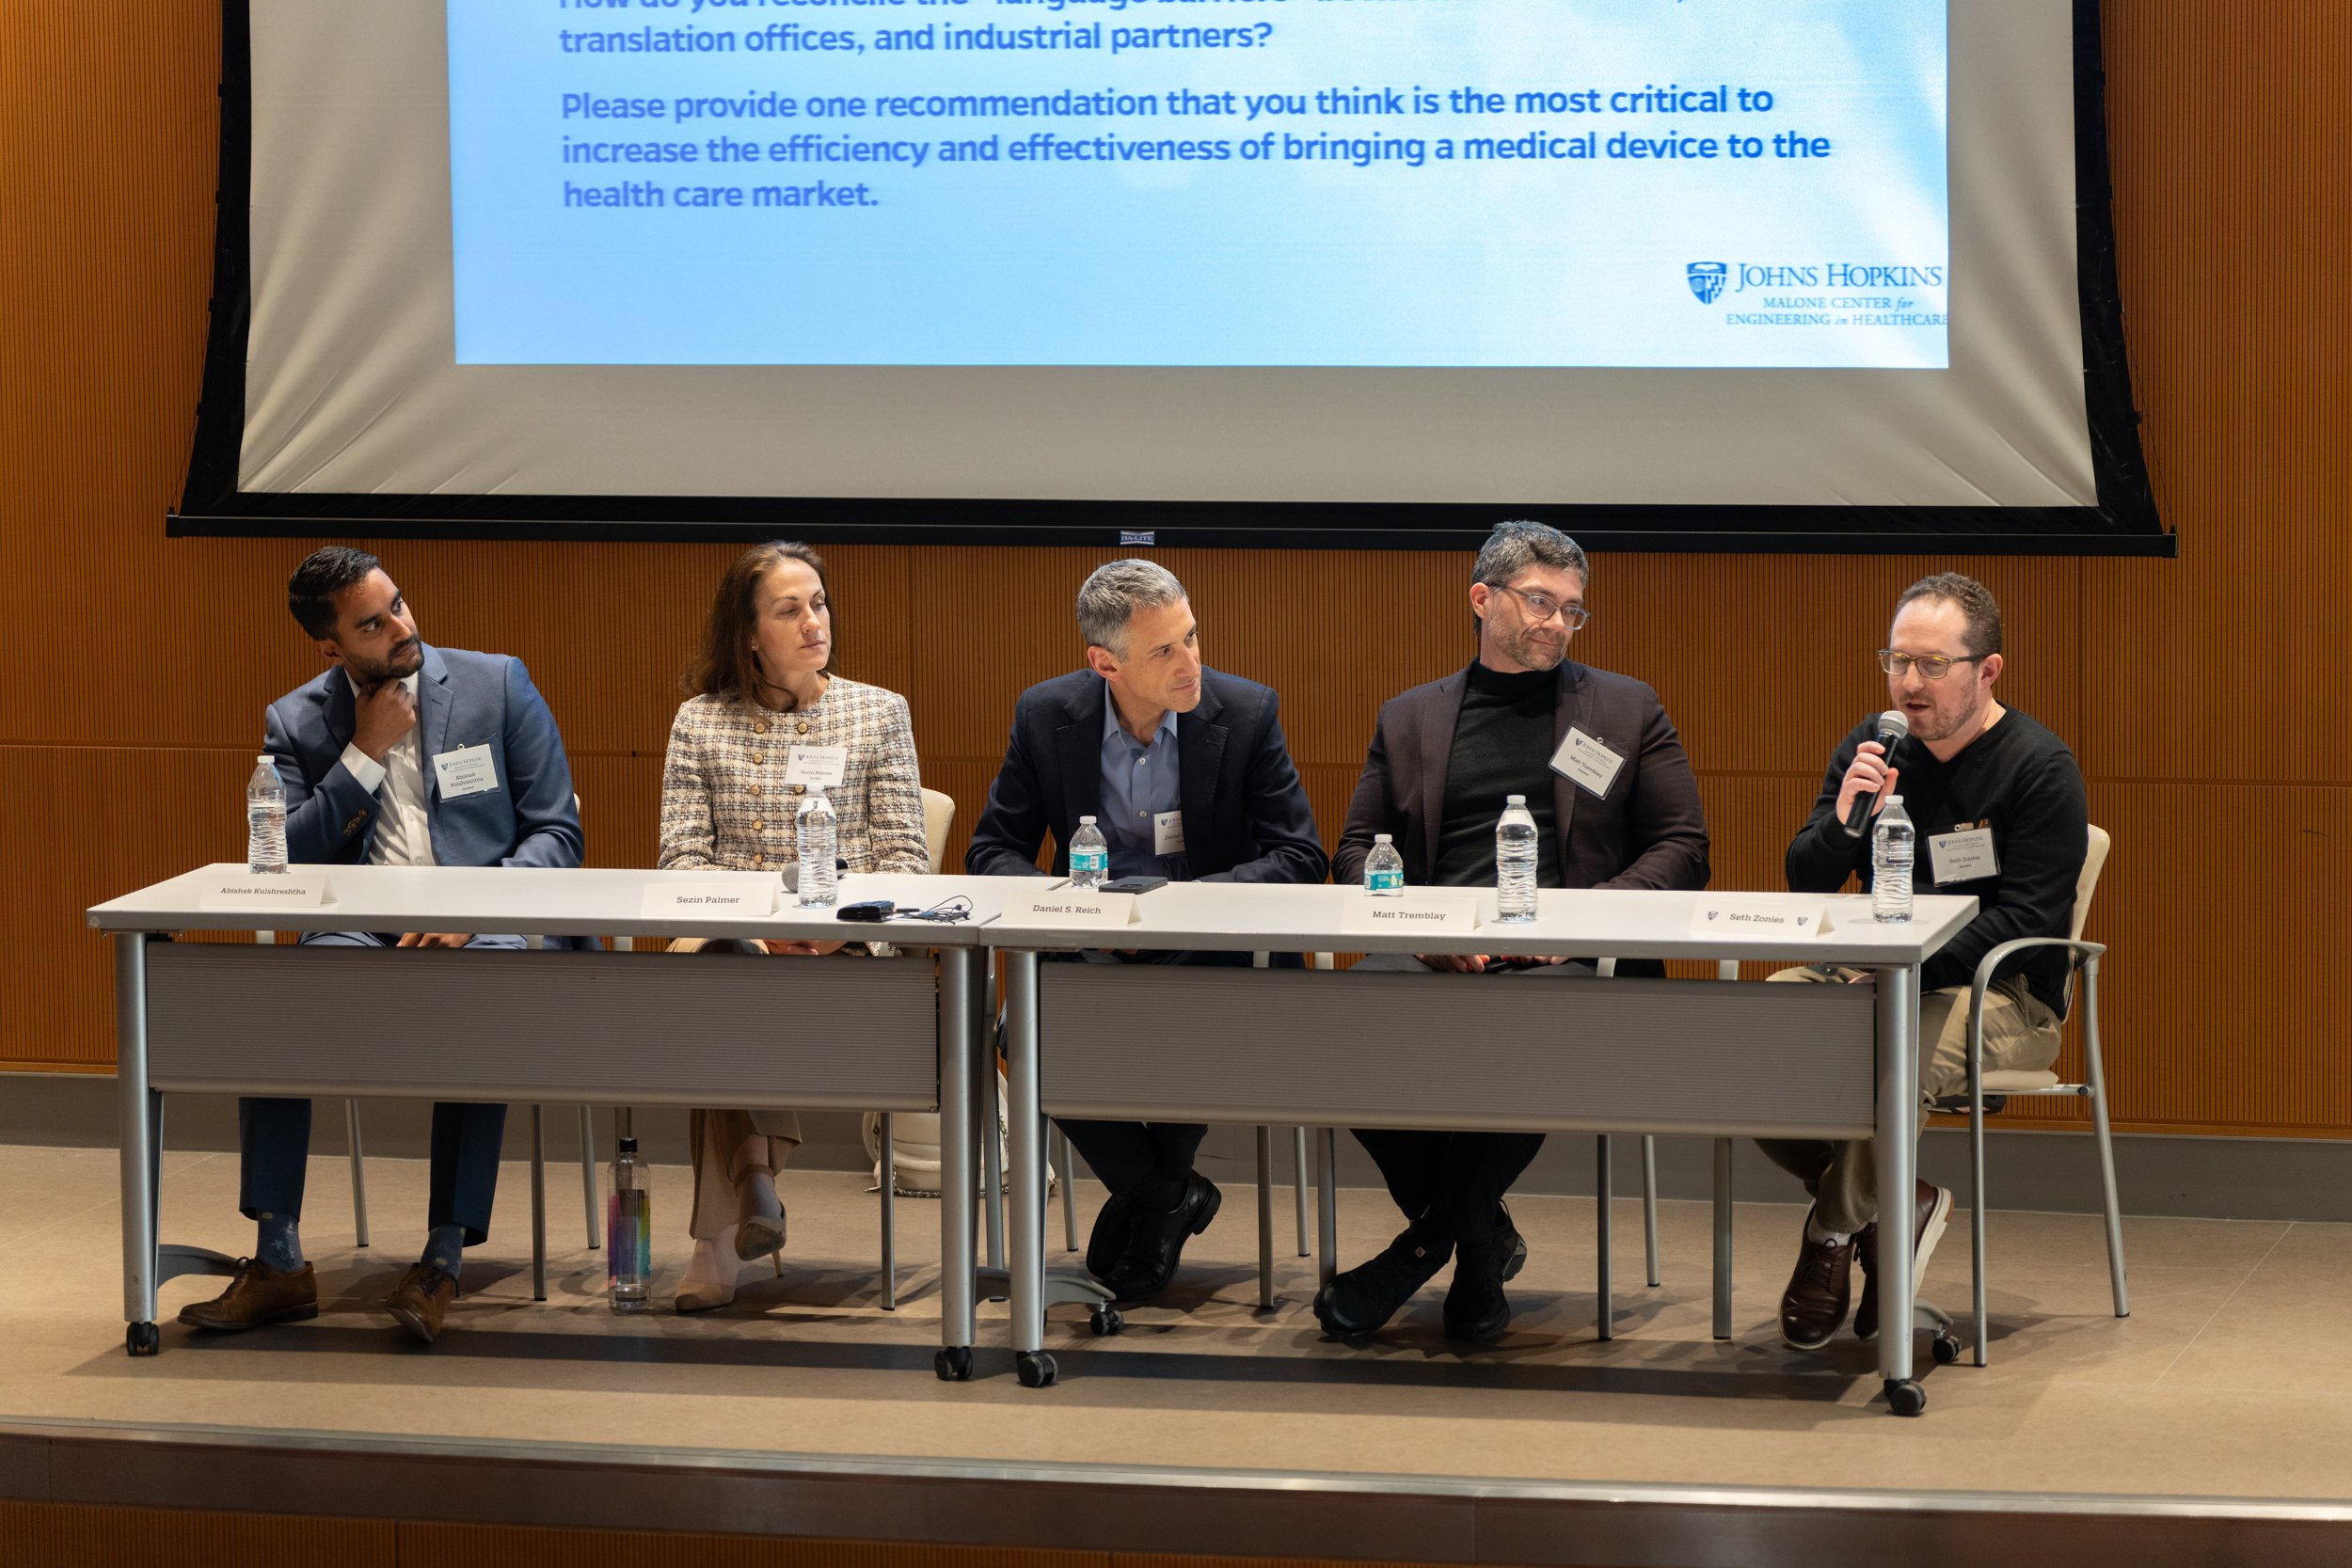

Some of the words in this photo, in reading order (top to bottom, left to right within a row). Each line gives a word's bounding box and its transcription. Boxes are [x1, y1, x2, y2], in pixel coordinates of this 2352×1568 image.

[560, 24, 736, 53] translation
[745, 24, 866, 55] offices,
[874, 24, 935, 51] and
[945, 21, 1102, 50] industrial
[1111, 22, 1274, 55] partners?
[564, 92, 665, 119] Please
[675, 90, 798, 123] provide
[806, 97, 866, 118] one
[876, 87, 1158, 118] recommendation
[1166, 88, 1237, 116] that
[1243, 94, 1307, 120] you
[1314, 86, 1406, 115] think
[1413, 85, 1440, 114] is
[1448, 86, 1506, 114] the
[1515, 88, 1603, 114] most
[1609, 83, 1729, 114] critical
[1736, 87, 1775, 113] to
[564, 135, 698, 163] increase
[707, 136, 760, 162] the
[769, 134, 930, 167] efficiency
[938, 135, 999, 162] and
[1008, 133, 1232, 161] effectiveness
[1239, 131, 1276, 161] of
[1283, 131, 1426, 167] bringing
[1434, 138, 1454, 160] a
[1463, 130, 1597, 160] medical
[1605, 129, 1720, 159] device
[1725, 134, 1765, 159] to
[1771, 129, 1833, 159] the
[564, 182, 664, 207] health
[675, 186, 743, 207] care
[753, 180, 879, 207] market.
[1735, 263, 1819, 293] JOHNS
[1826, 263, 1943, 288] HOPKINS
[1763, 297, 1826, 309] MALONE
[1831, 297, 1891, 309] CENTER
[1726, 313, 1831, 325] ENGINEERING
[1033, 904, 1063, 913] Daniel
[1075, 906, 1102, 914] Reich
[1373, 911, 1395, 919] Matt
[1398, 911, 1446, 921] Tremblay
[1729, 913, 1752, 922] Seth
[1753, 915, 1785, 924] Zonies
